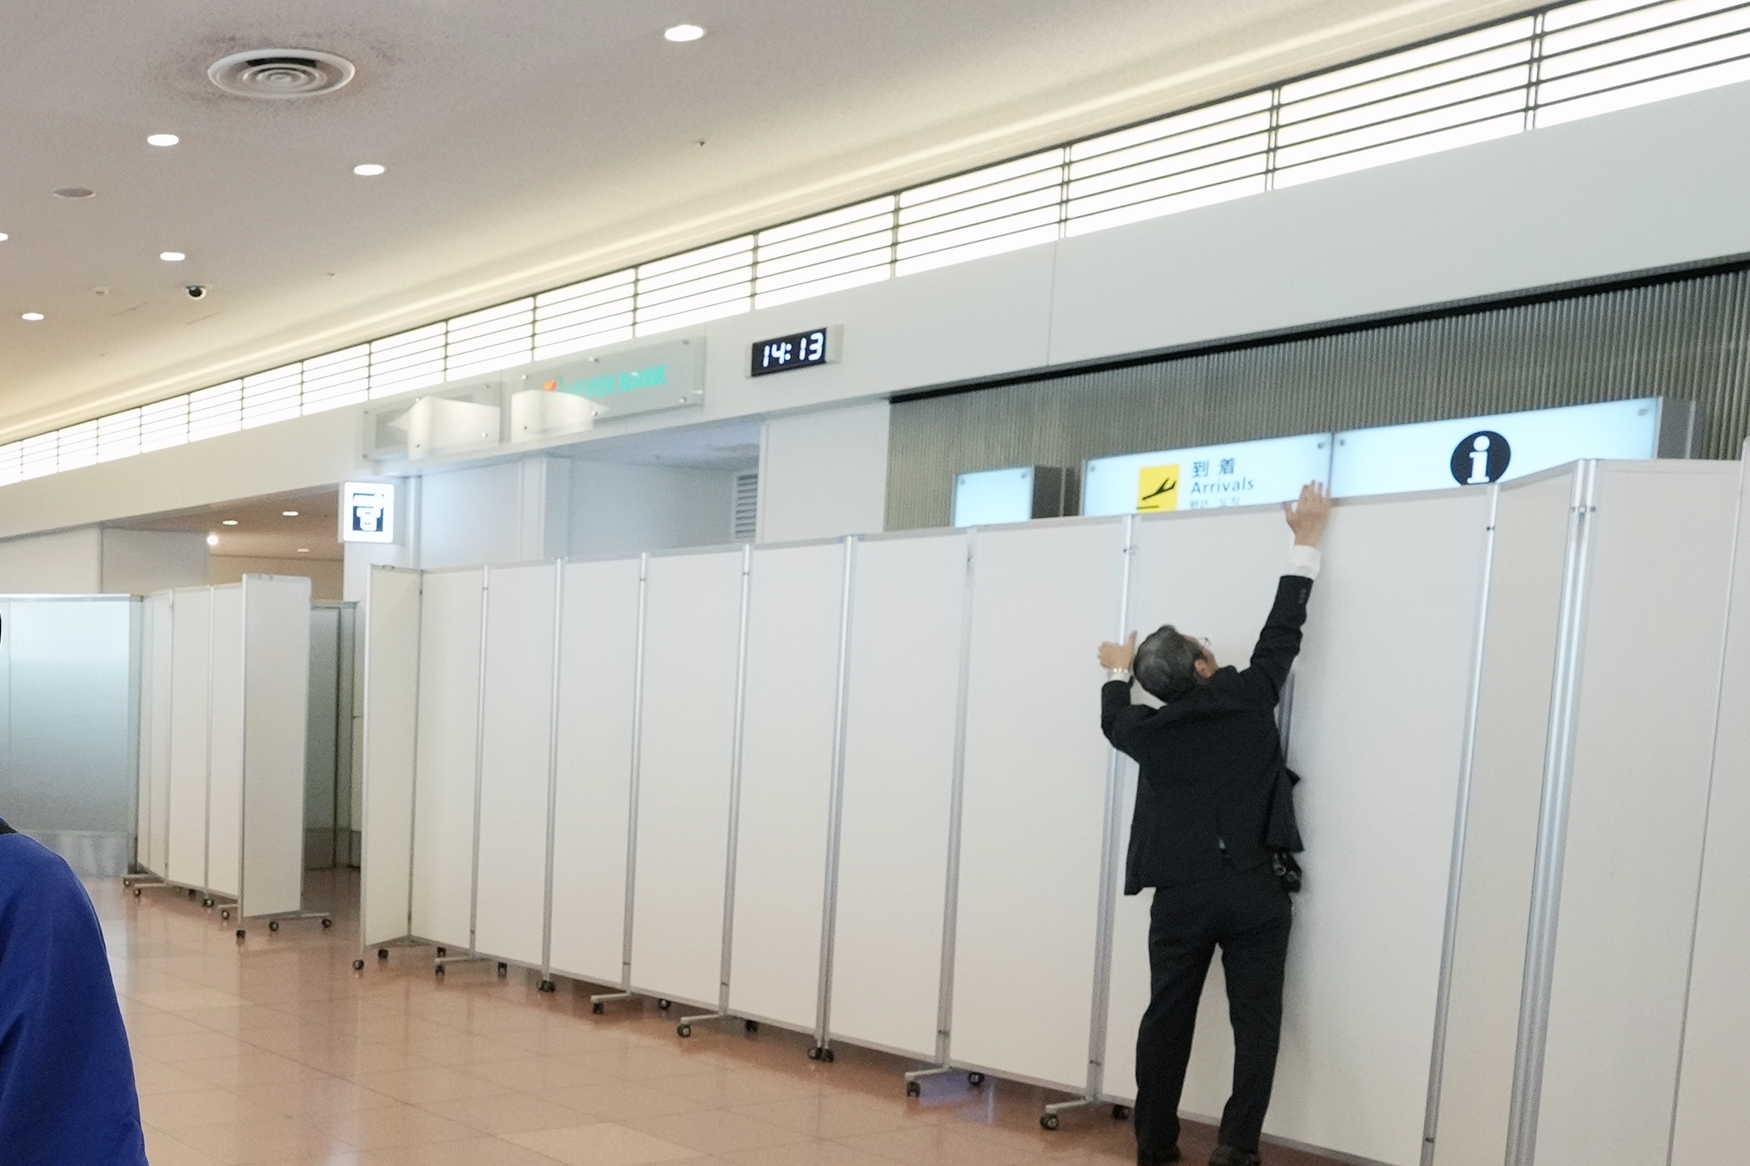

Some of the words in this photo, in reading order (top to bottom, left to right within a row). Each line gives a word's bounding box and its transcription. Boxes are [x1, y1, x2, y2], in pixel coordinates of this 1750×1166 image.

[763, 332, 824, 367] 14:13
[1191, 458, 1235, 478] 到着
[1190, 477, 1254, 495] Arrivals
